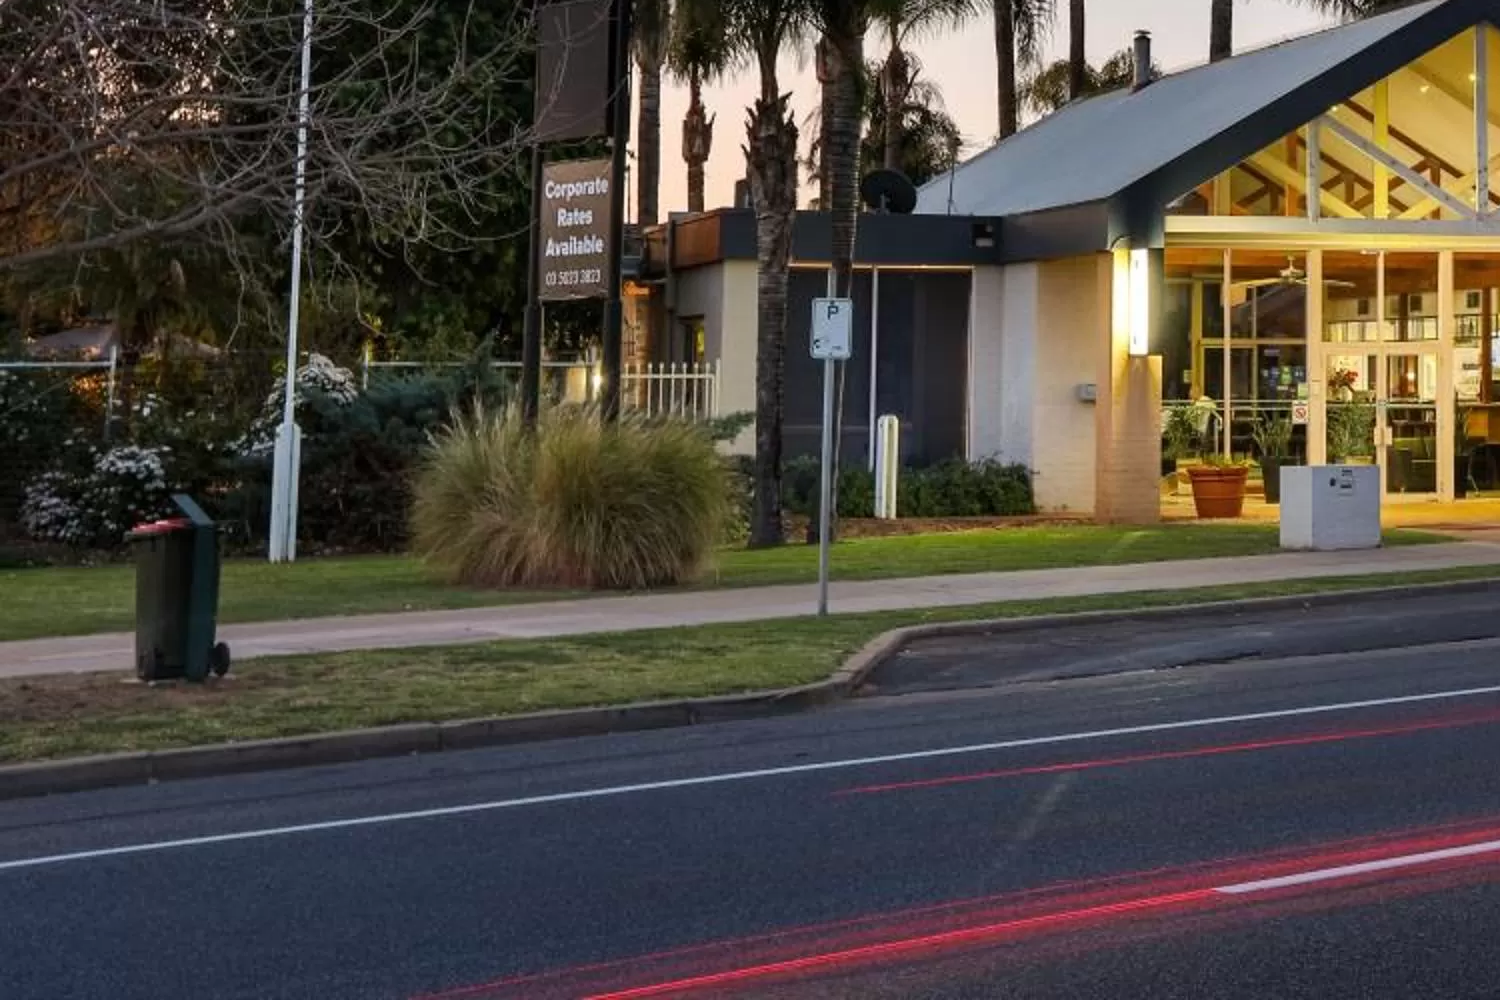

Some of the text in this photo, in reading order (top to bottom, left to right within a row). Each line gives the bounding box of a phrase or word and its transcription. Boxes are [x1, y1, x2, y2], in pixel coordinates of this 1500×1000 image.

[545, 177, 609, 200] Corporate
[557, 207, 593, 226] Rates
[545, 235, 604, 257] Available
[827, 305, 839, 320] P
